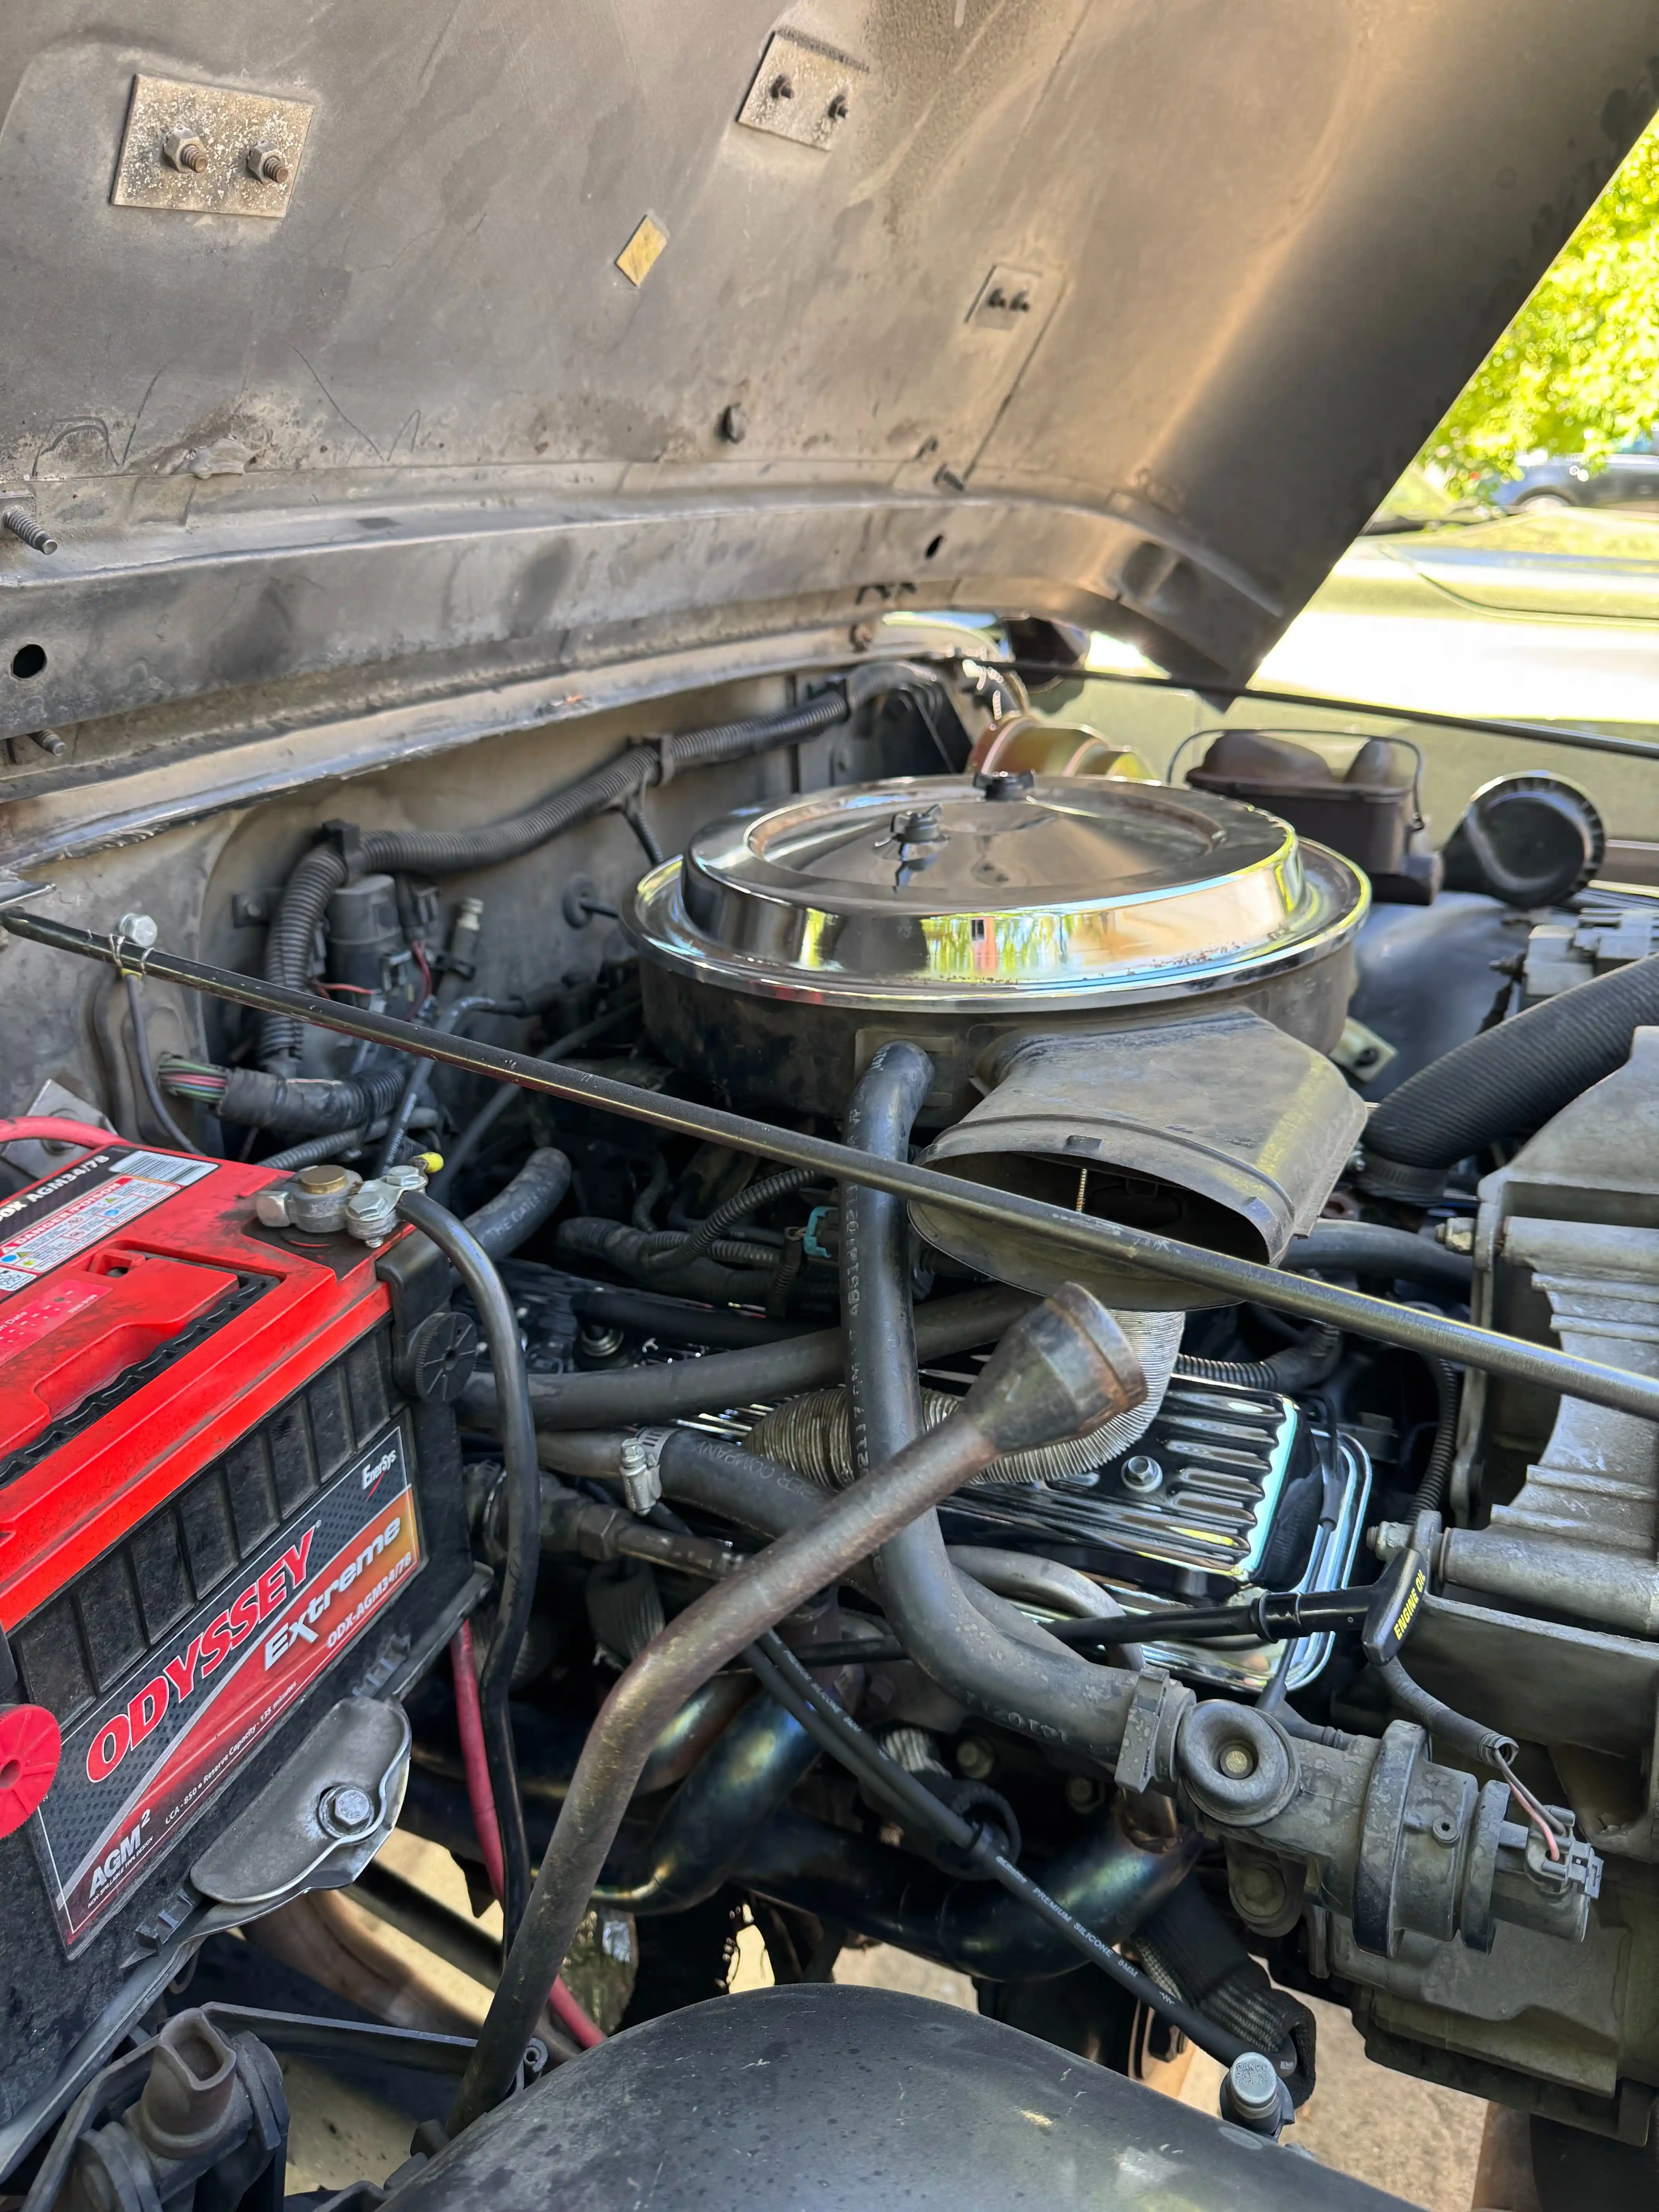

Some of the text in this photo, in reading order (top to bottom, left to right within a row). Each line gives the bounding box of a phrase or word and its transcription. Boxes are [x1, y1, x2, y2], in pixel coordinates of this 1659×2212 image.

[0, 1201, 28, 1221] DX
[362, 1449, 396, 1490] EnerSys
[692, 1441, 775, 1479] COMPANY
[265, 1516, 401, 1671] Extreme
[326, 1551, 411, 1648] ODX-AGM34/78
[1394, 1570, 1425, 1640] ENGINE OIL
[86, 1524, 316, 1783] ODYSSEY
[184, 1787, 197, 1805] 850
[203, 1754, 229, 1784] Reserve
[228, 1723, 257, 1755] Capacity
[260, 1706, 272, 1722] 135
[273, 1680, 297, 1709] minutes
[88, 1866, 124, 1909] NON-SPILLABLE
[136, 1836, 153, 1856] DESIGN
[1033, 1887, 1072, 1922] PREMIUM
[1073, 1922, 1114, 1957] SILICONE
[1118, 1959, 1138, 1977] 8MM
